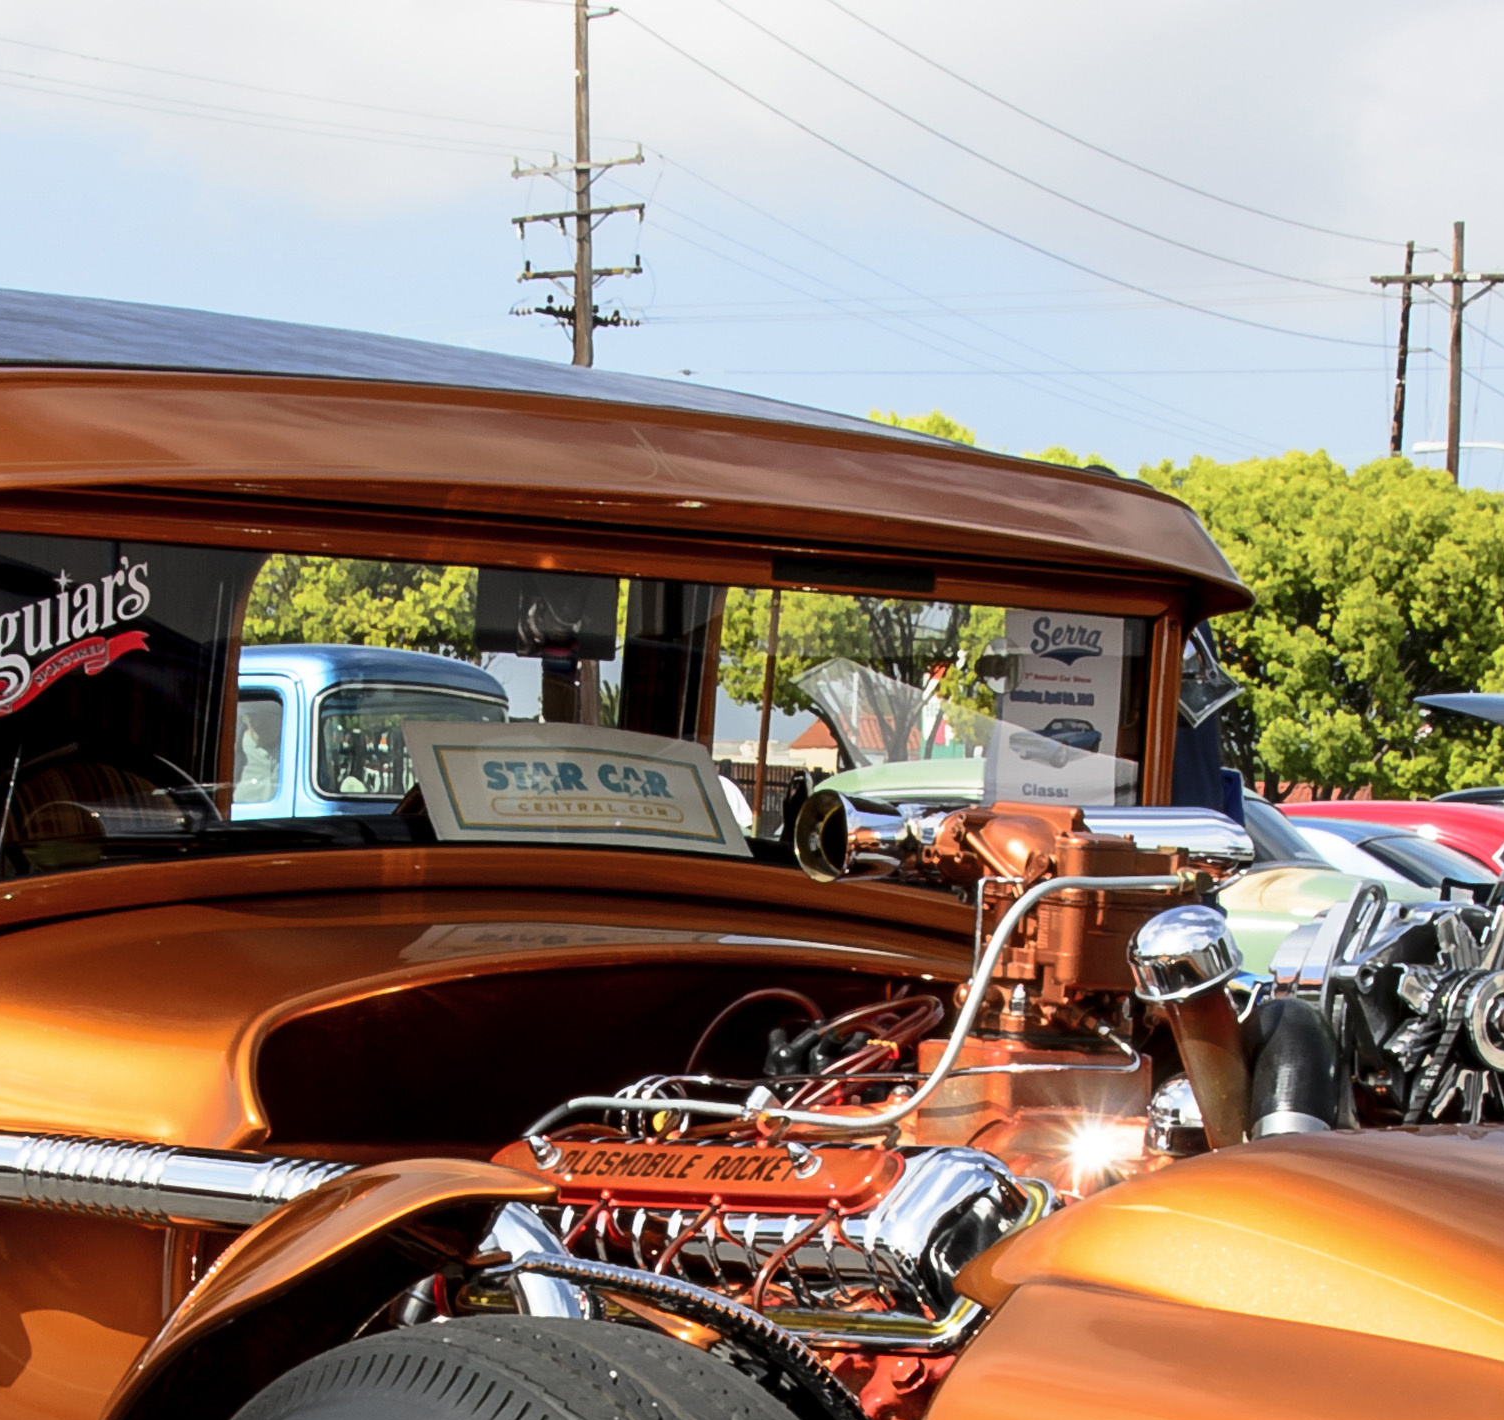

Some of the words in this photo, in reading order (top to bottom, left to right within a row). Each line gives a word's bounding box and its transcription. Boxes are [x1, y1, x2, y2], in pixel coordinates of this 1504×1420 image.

[1030, 616, 1103, 657] Serra
[482, 760, 589, 795] STAR
[597, 764, 674, 799] CAR
[1021, 782, 1069, 798] Class:
[555, 1150, 703, 1179] OLDSMOBILE
